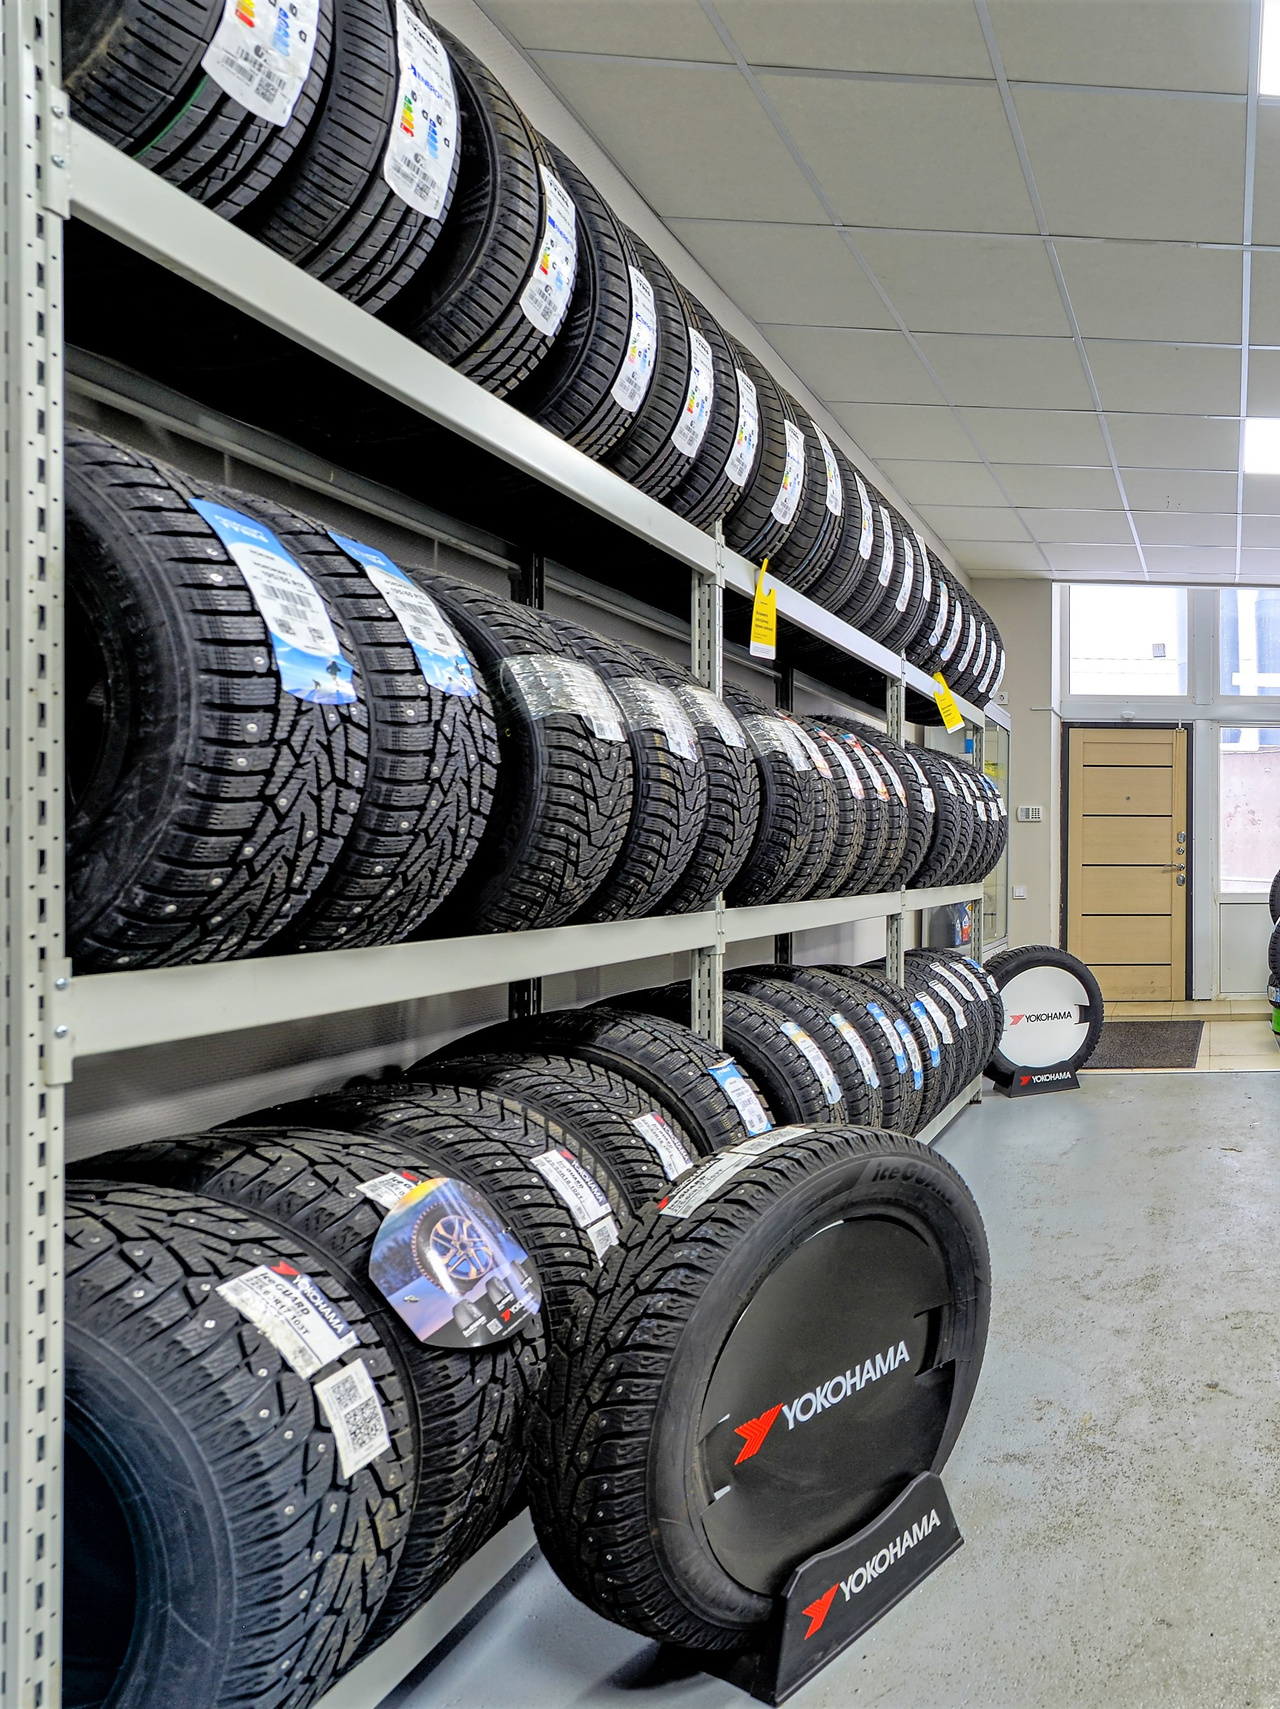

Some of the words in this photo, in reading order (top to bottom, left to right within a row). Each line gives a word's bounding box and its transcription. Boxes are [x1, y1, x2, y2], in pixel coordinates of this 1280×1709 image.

[1024, 1010, 1073, 1024] YOKOHAMA
[1031, 1071, 1072, 1084] YOKOHAMA
[661, 1123, 690, 1162] YOKOHAMA
[571, 1160, 604, 1203] YOKOHAMA
[669, 1158, 722, 1197] YOKOHAMA
[292, 1274, 346, 1335] YOKOHAMA
[290, 1314, 311, 1336] 103T
[781, 1340, 910, 1431] YOKOHAMA
[839, 1508, 942, 1602] YOKOHAMA
